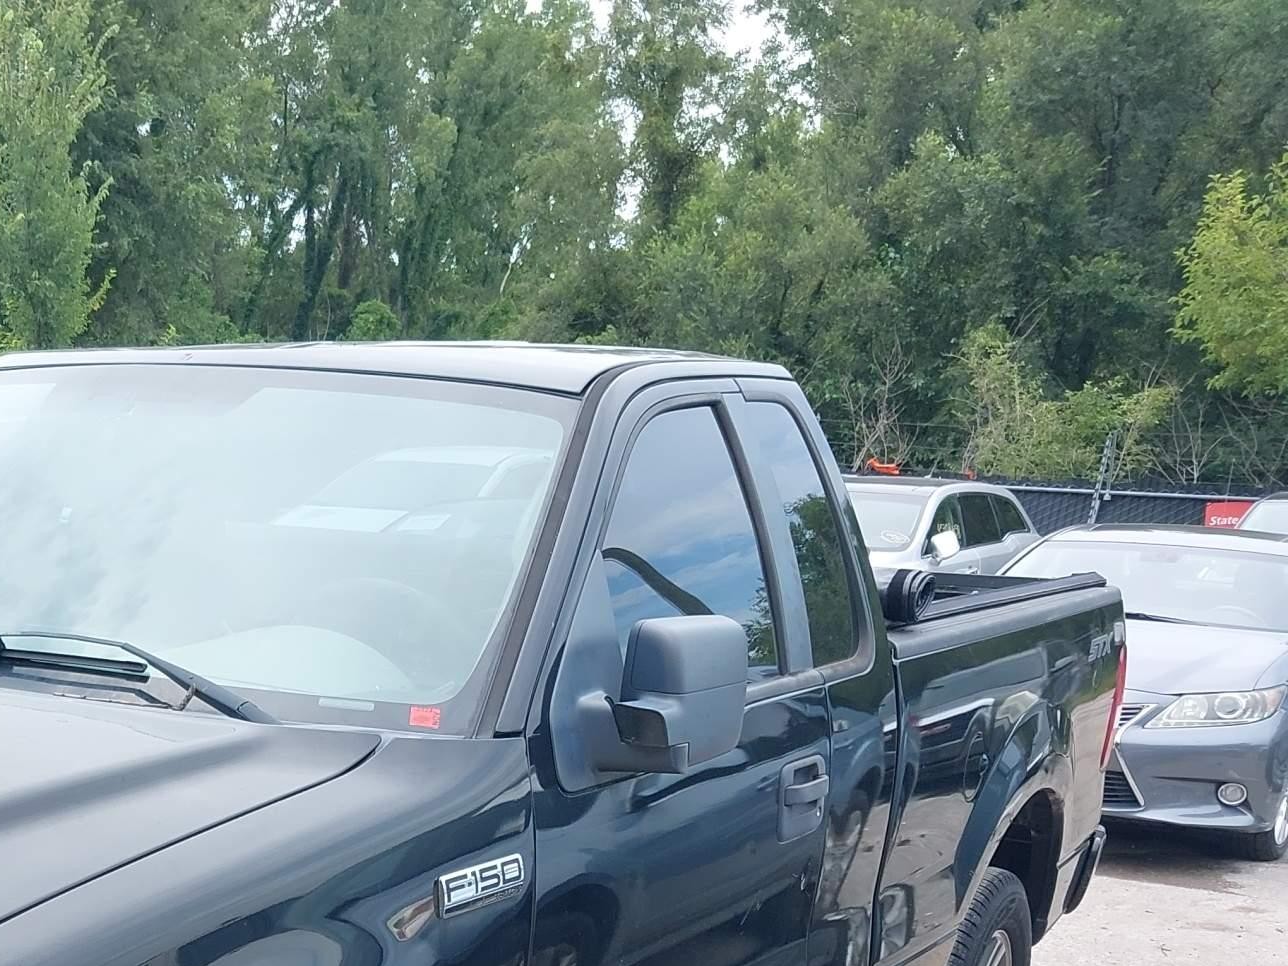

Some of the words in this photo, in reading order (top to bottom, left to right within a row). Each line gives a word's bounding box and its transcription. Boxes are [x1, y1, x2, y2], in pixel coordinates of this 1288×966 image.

[1209, 516, 1240, 526] State
[1088, 631, 1114, 662] STX
[444, 857, 523, 904] F-150
